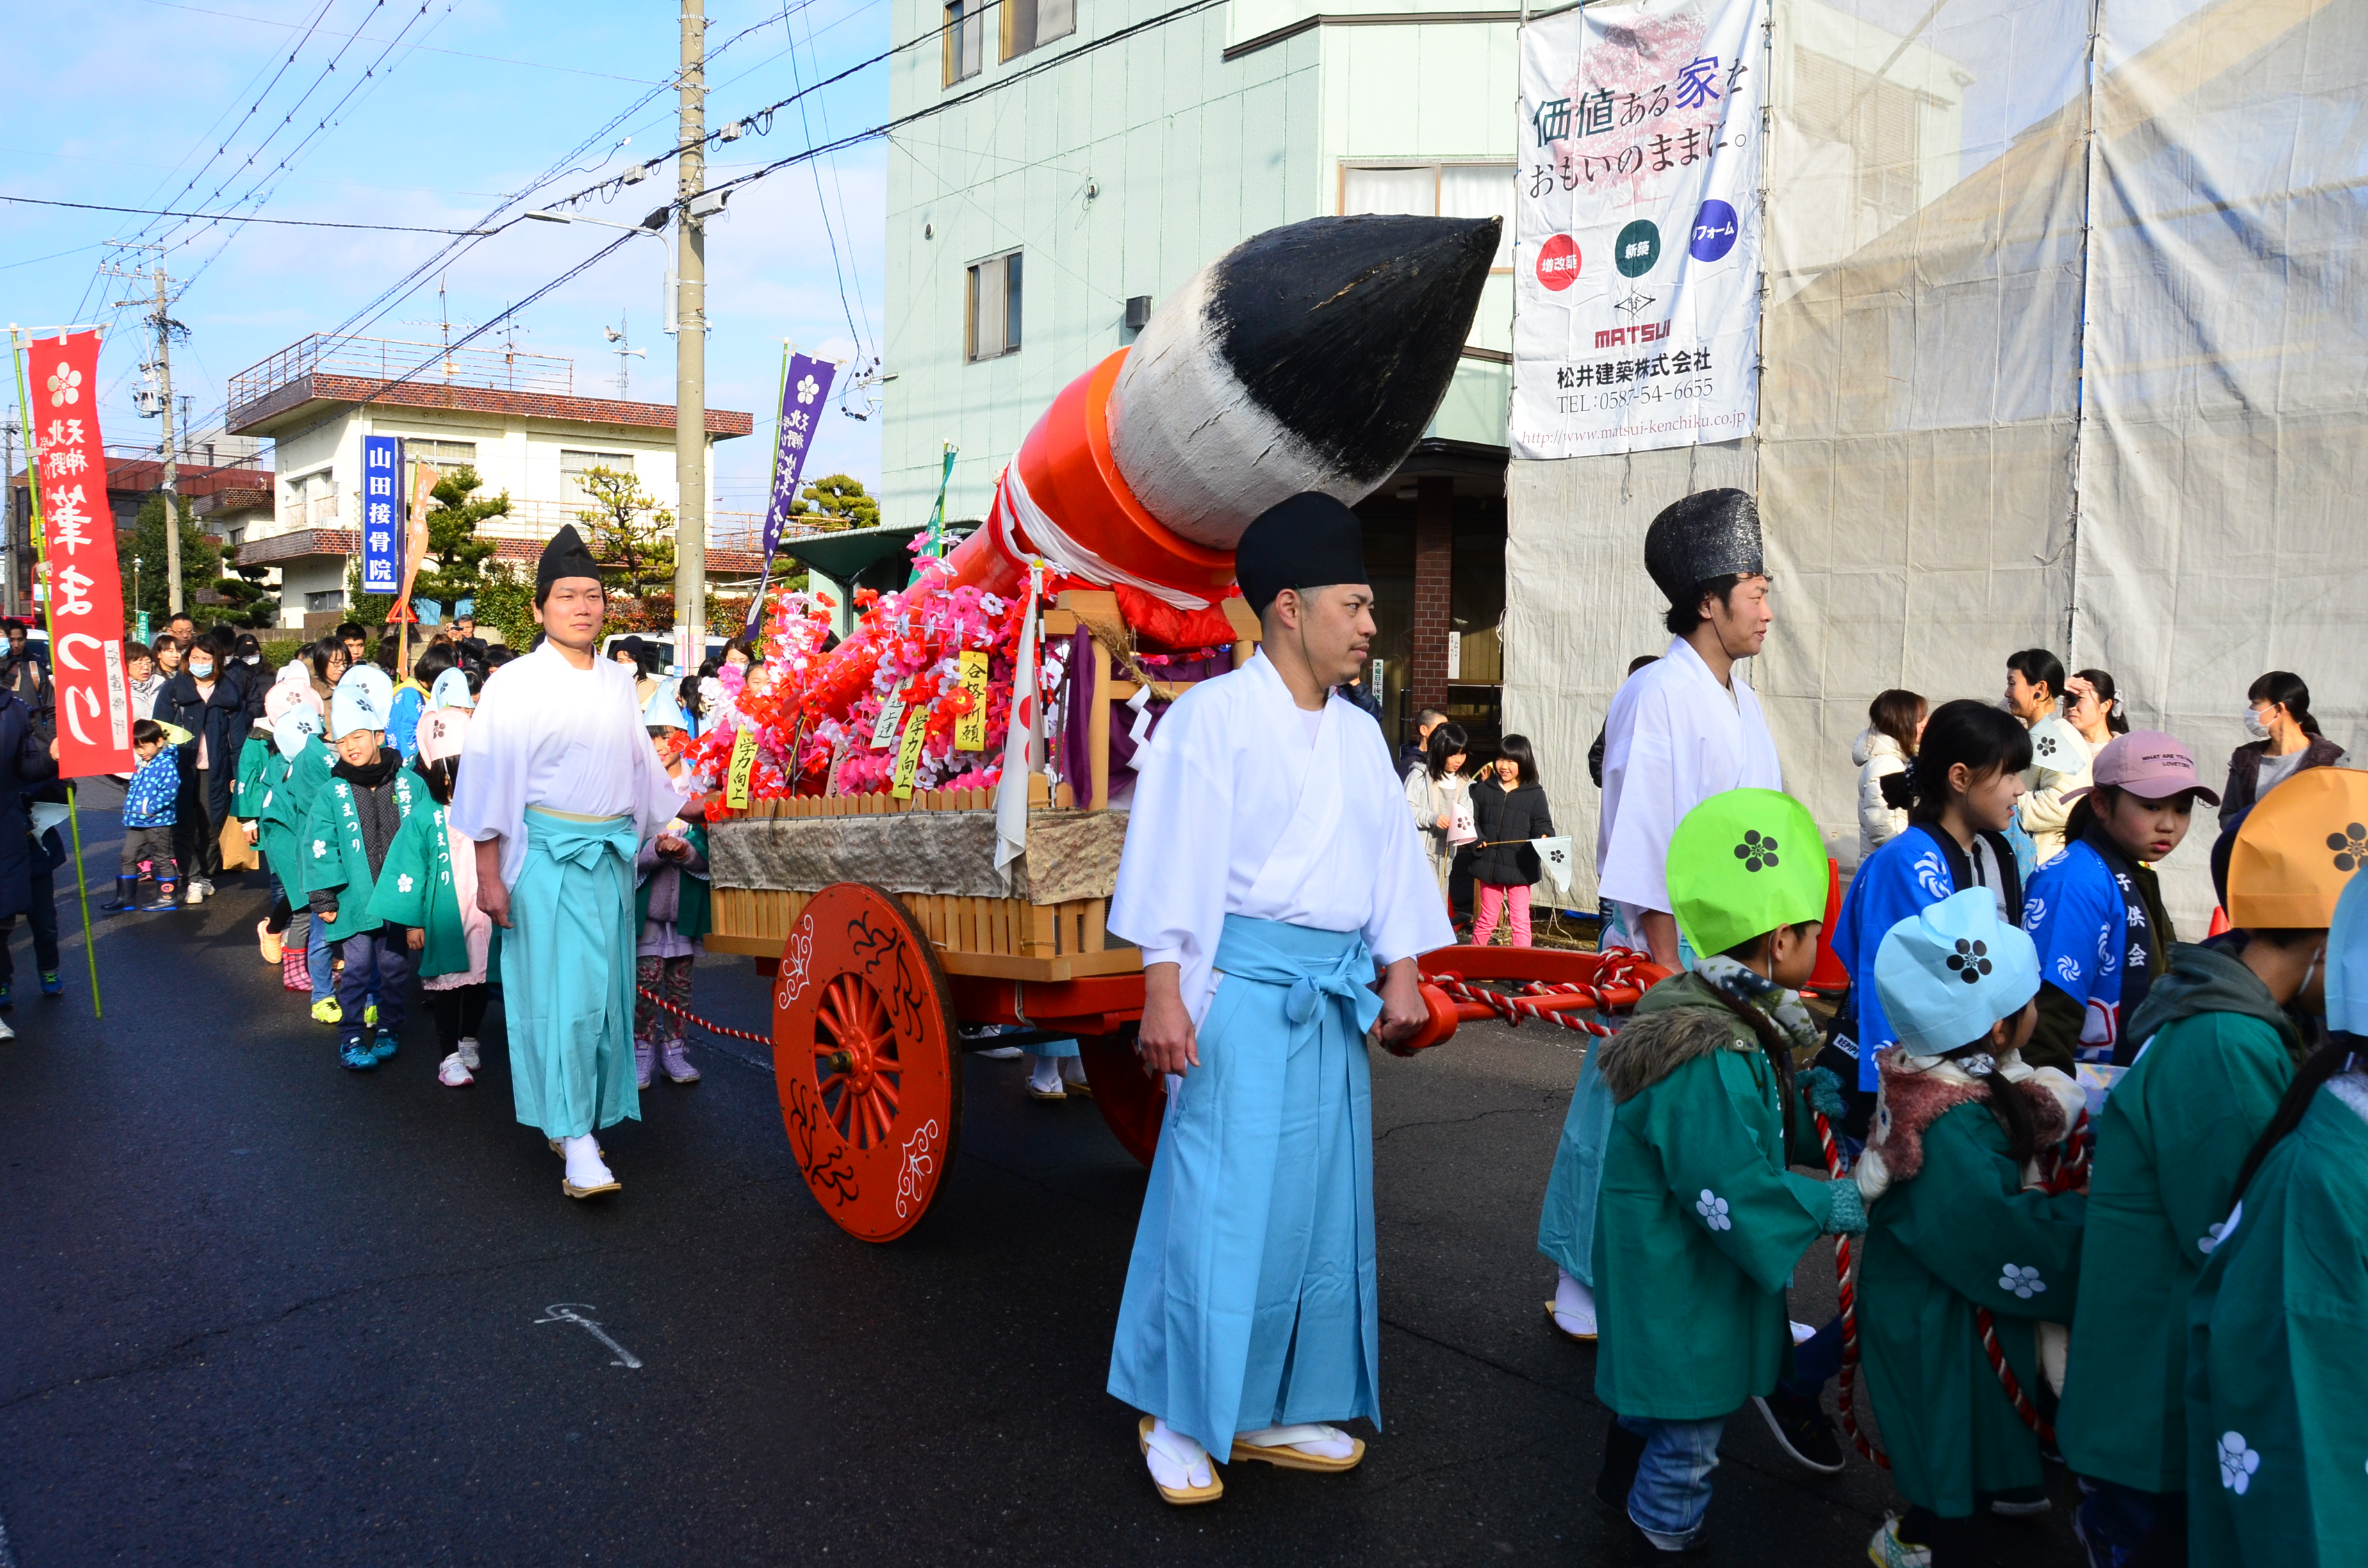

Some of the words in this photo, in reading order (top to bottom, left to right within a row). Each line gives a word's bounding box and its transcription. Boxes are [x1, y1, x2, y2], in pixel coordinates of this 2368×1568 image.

[1533, 56, 1748, 148] 価値ある家を
[1625, 240, 1650, 260] 新築
[1691, 221, 1734, 241] リフォーム
[1542, 254, 1577, 274] 増改築
[1595, 318, 1671, 349] MATSUI
[1556, 347, 1713, 390] 松井建築株式会社
[1521, 409, 1746, 448] http://www.matsui-kenchiku.co.jp
[368, 447, 391, 581] 山田接骨院
[960, 662, 987, 743] 合格祈願
[732, 738, 757, 800] 学力向上
[898, 714, 928, 788] 学力向上
[335, 783, 361, 853] 筆まつり
[433, 810, 450, 886] 筆まつり
[2115, 873, 2148, 968] 子供会
[1836, 1037, 1859, 1056] REPIPI
